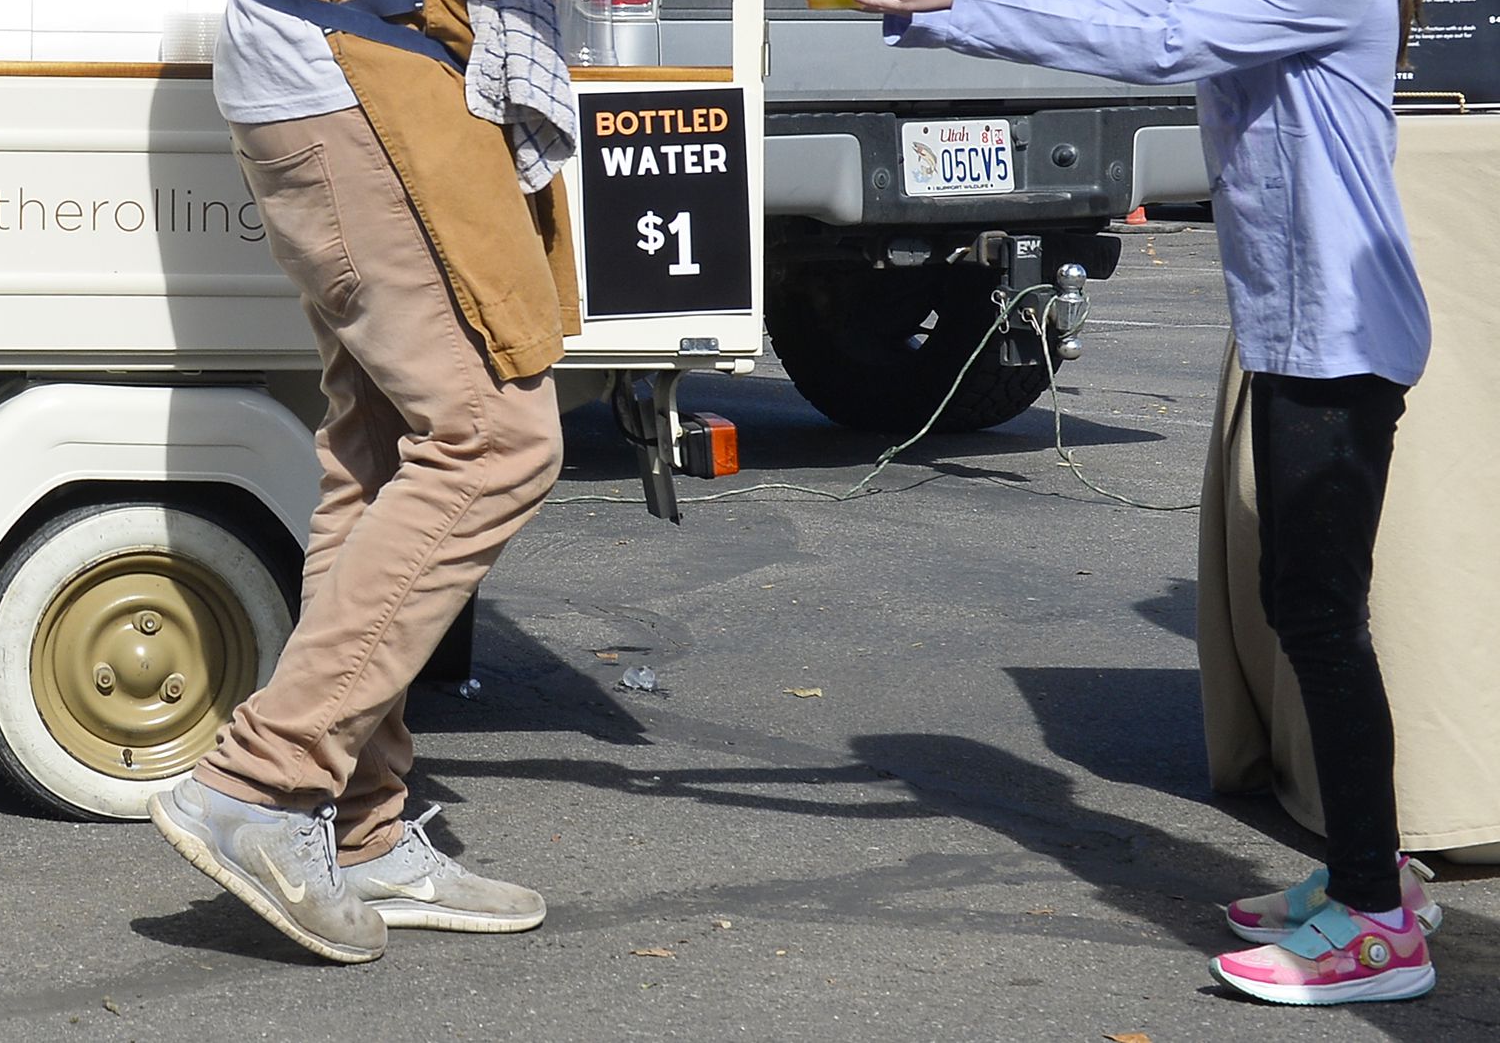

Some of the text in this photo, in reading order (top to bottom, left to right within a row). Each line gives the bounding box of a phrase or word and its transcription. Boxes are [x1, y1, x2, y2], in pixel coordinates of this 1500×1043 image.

[596, 108, 728, 136] BOTTLED
[940, 126, 969, 142] Utah
[602, 143, 728, 176] WATER
[941, 146, 1008, 182] 05CV5
[637, 210, 700, 276] $1
